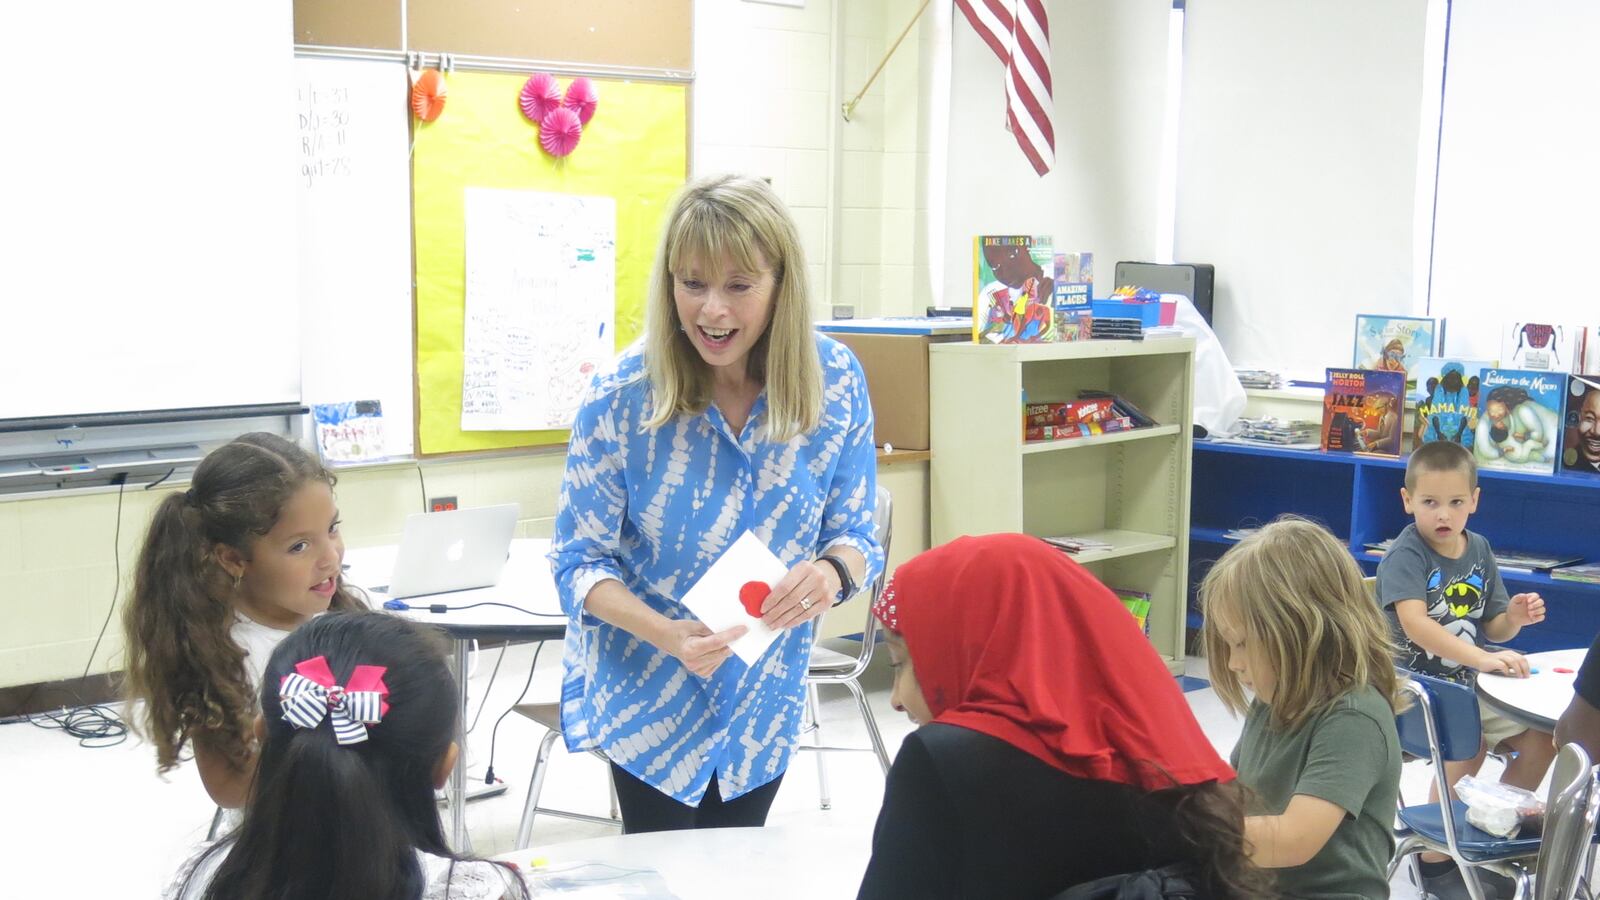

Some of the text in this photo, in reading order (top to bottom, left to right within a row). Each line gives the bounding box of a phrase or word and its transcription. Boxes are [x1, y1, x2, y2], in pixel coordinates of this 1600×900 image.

[1056, 284, 1088, 295] AMAZING
[1056, 294, 1088, 306] PLACES
[1482, 370, 1557, 395] Ladder to the Moon
[1332, 393, 1364, 407] JAZZ
[1419, 402, 1456, 417] MAMA
